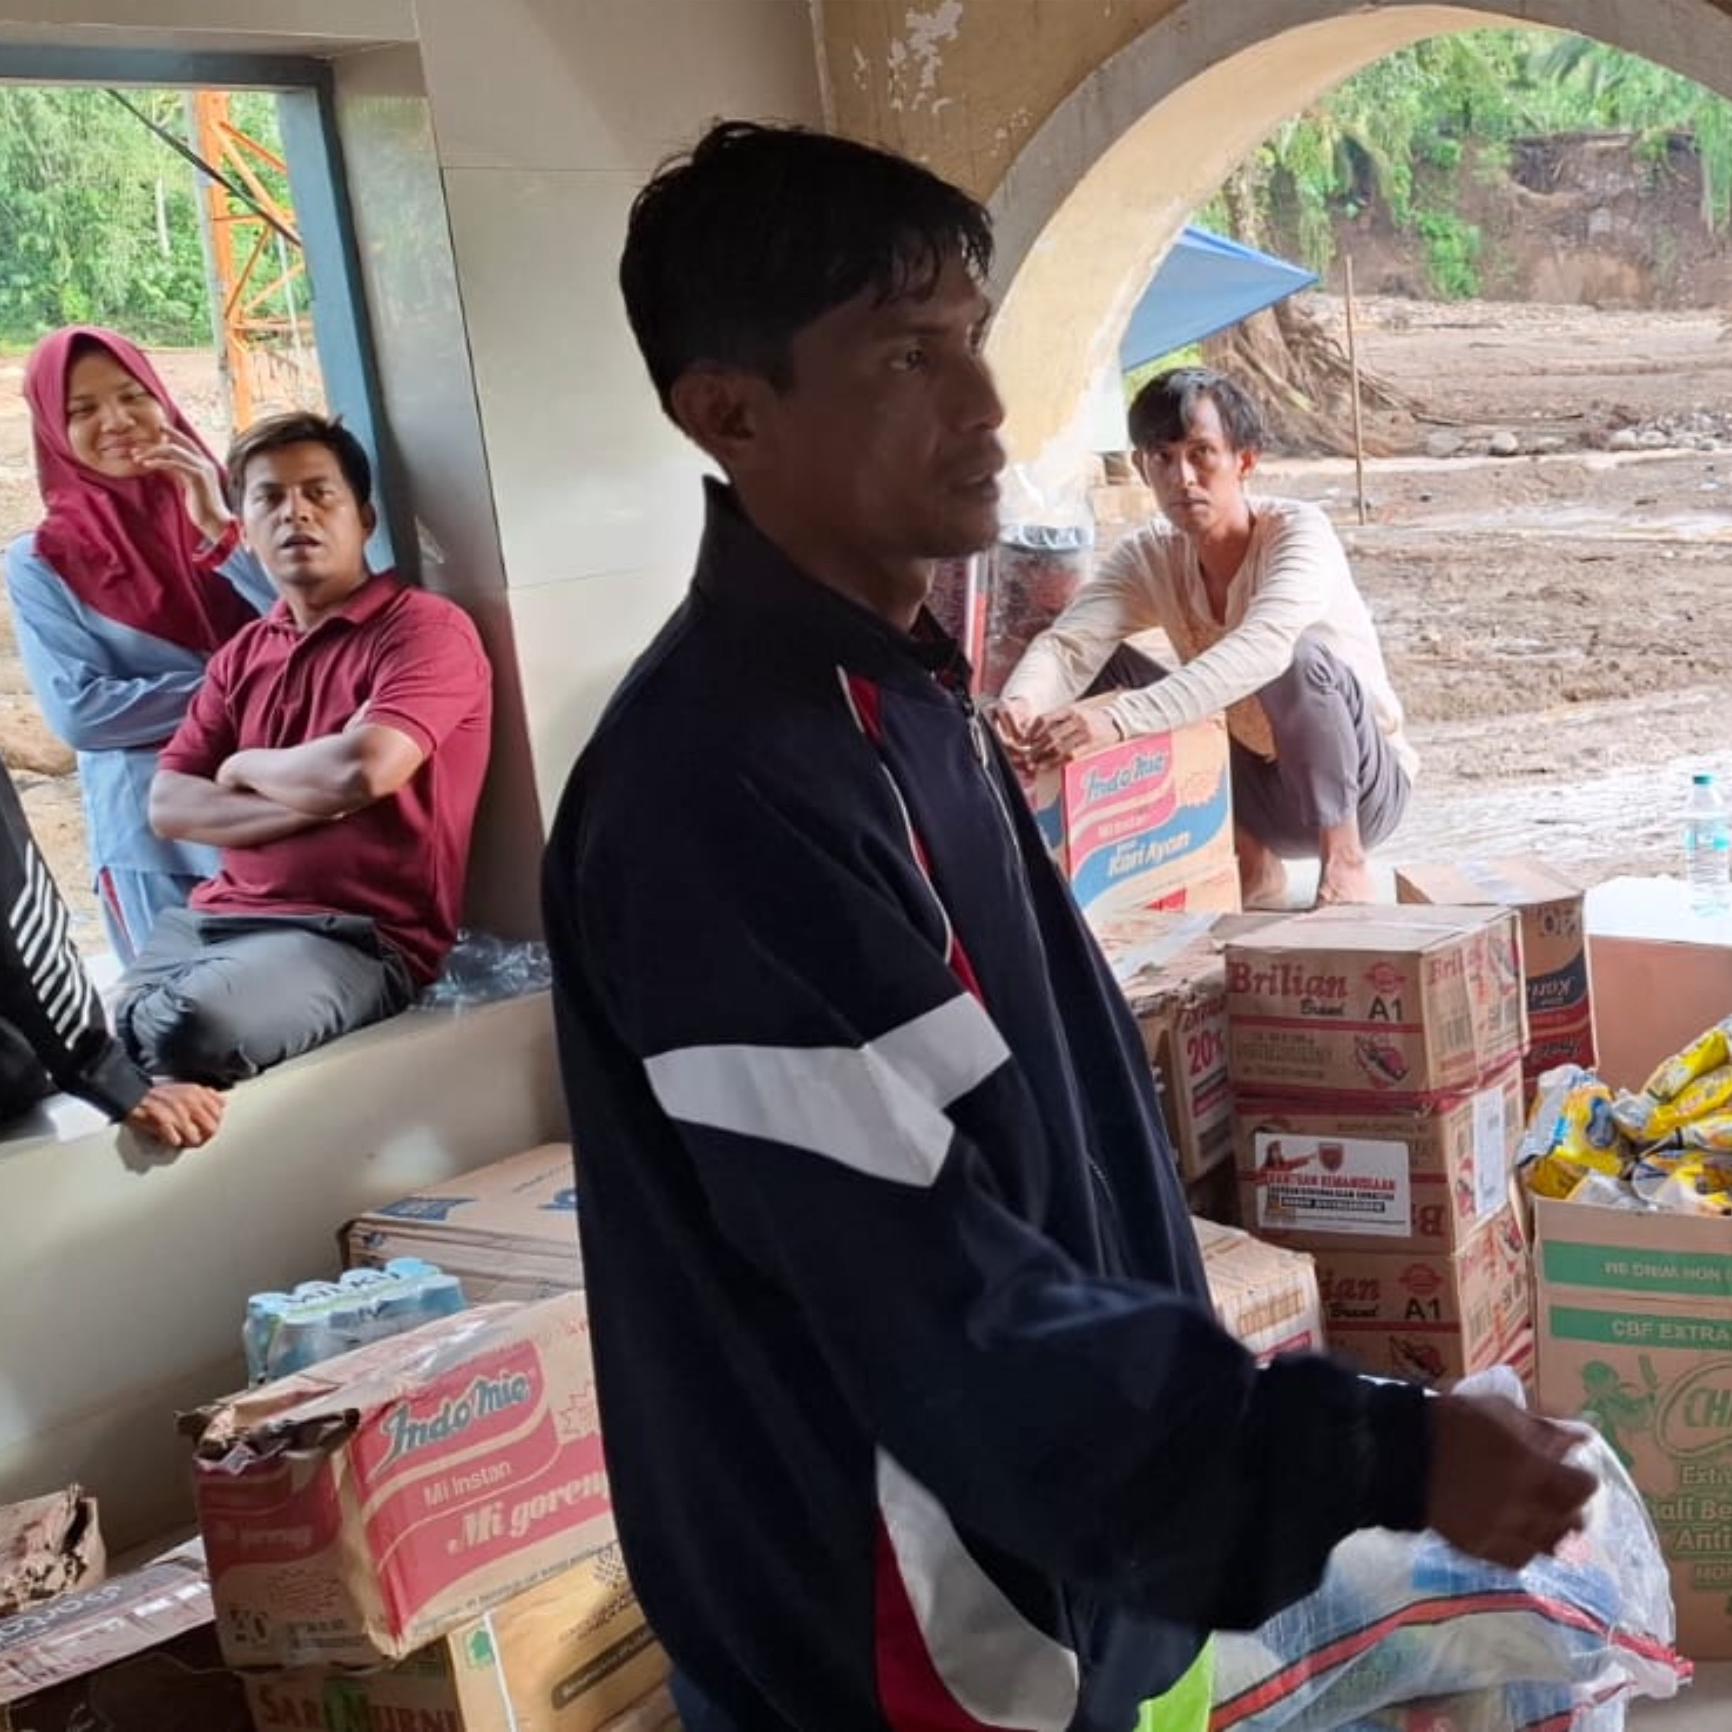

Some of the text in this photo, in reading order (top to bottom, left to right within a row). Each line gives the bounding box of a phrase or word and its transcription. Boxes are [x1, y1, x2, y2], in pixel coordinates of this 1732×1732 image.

[1226, 961, 1350, 998] Brilian
[1368, 996, 1403, 1021] A1
[1404, 1296, 1441, 1320] A1
[1658, 1322, 1730, 1343] EXTRA
[1675, 1526, 1732, 1551] Anti
